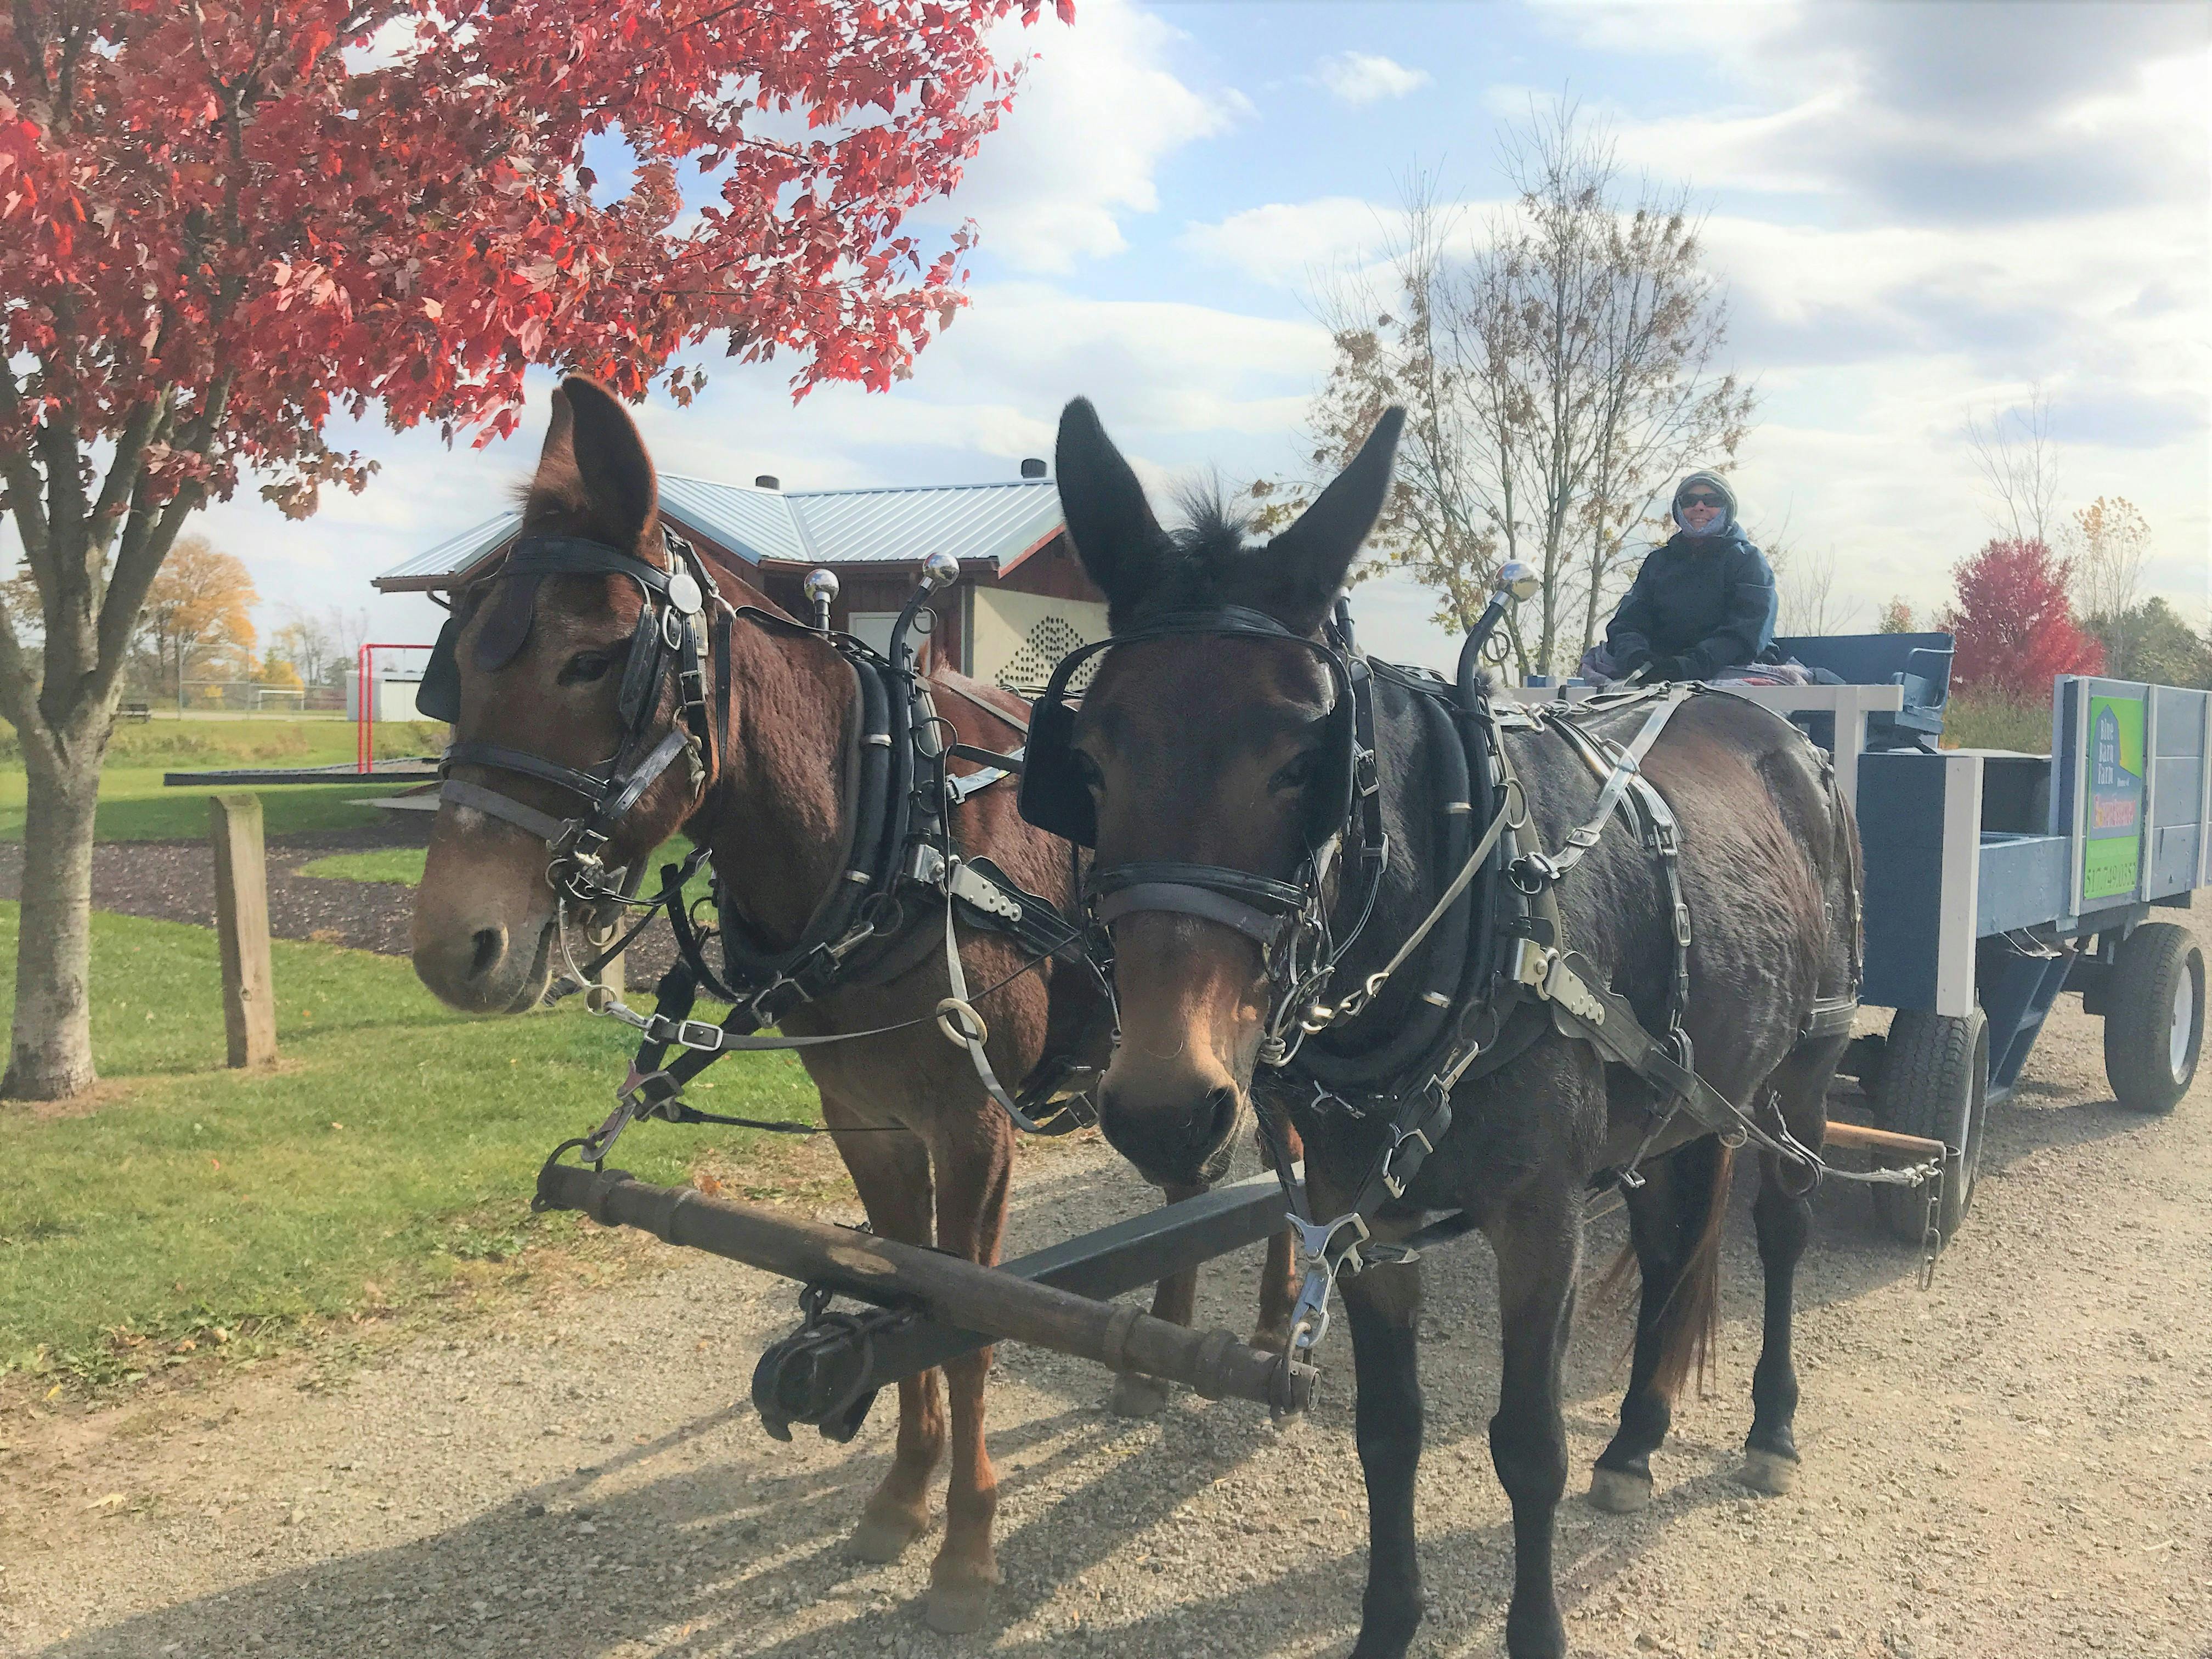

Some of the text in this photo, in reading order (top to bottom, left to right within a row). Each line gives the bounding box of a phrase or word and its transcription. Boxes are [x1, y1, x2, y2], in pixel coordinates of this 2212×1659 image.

[2100, 718, 2114, 741] Blue
[2098, 742, 2113, 763] Barn
[2097, 763, 2113, 785] Farm
